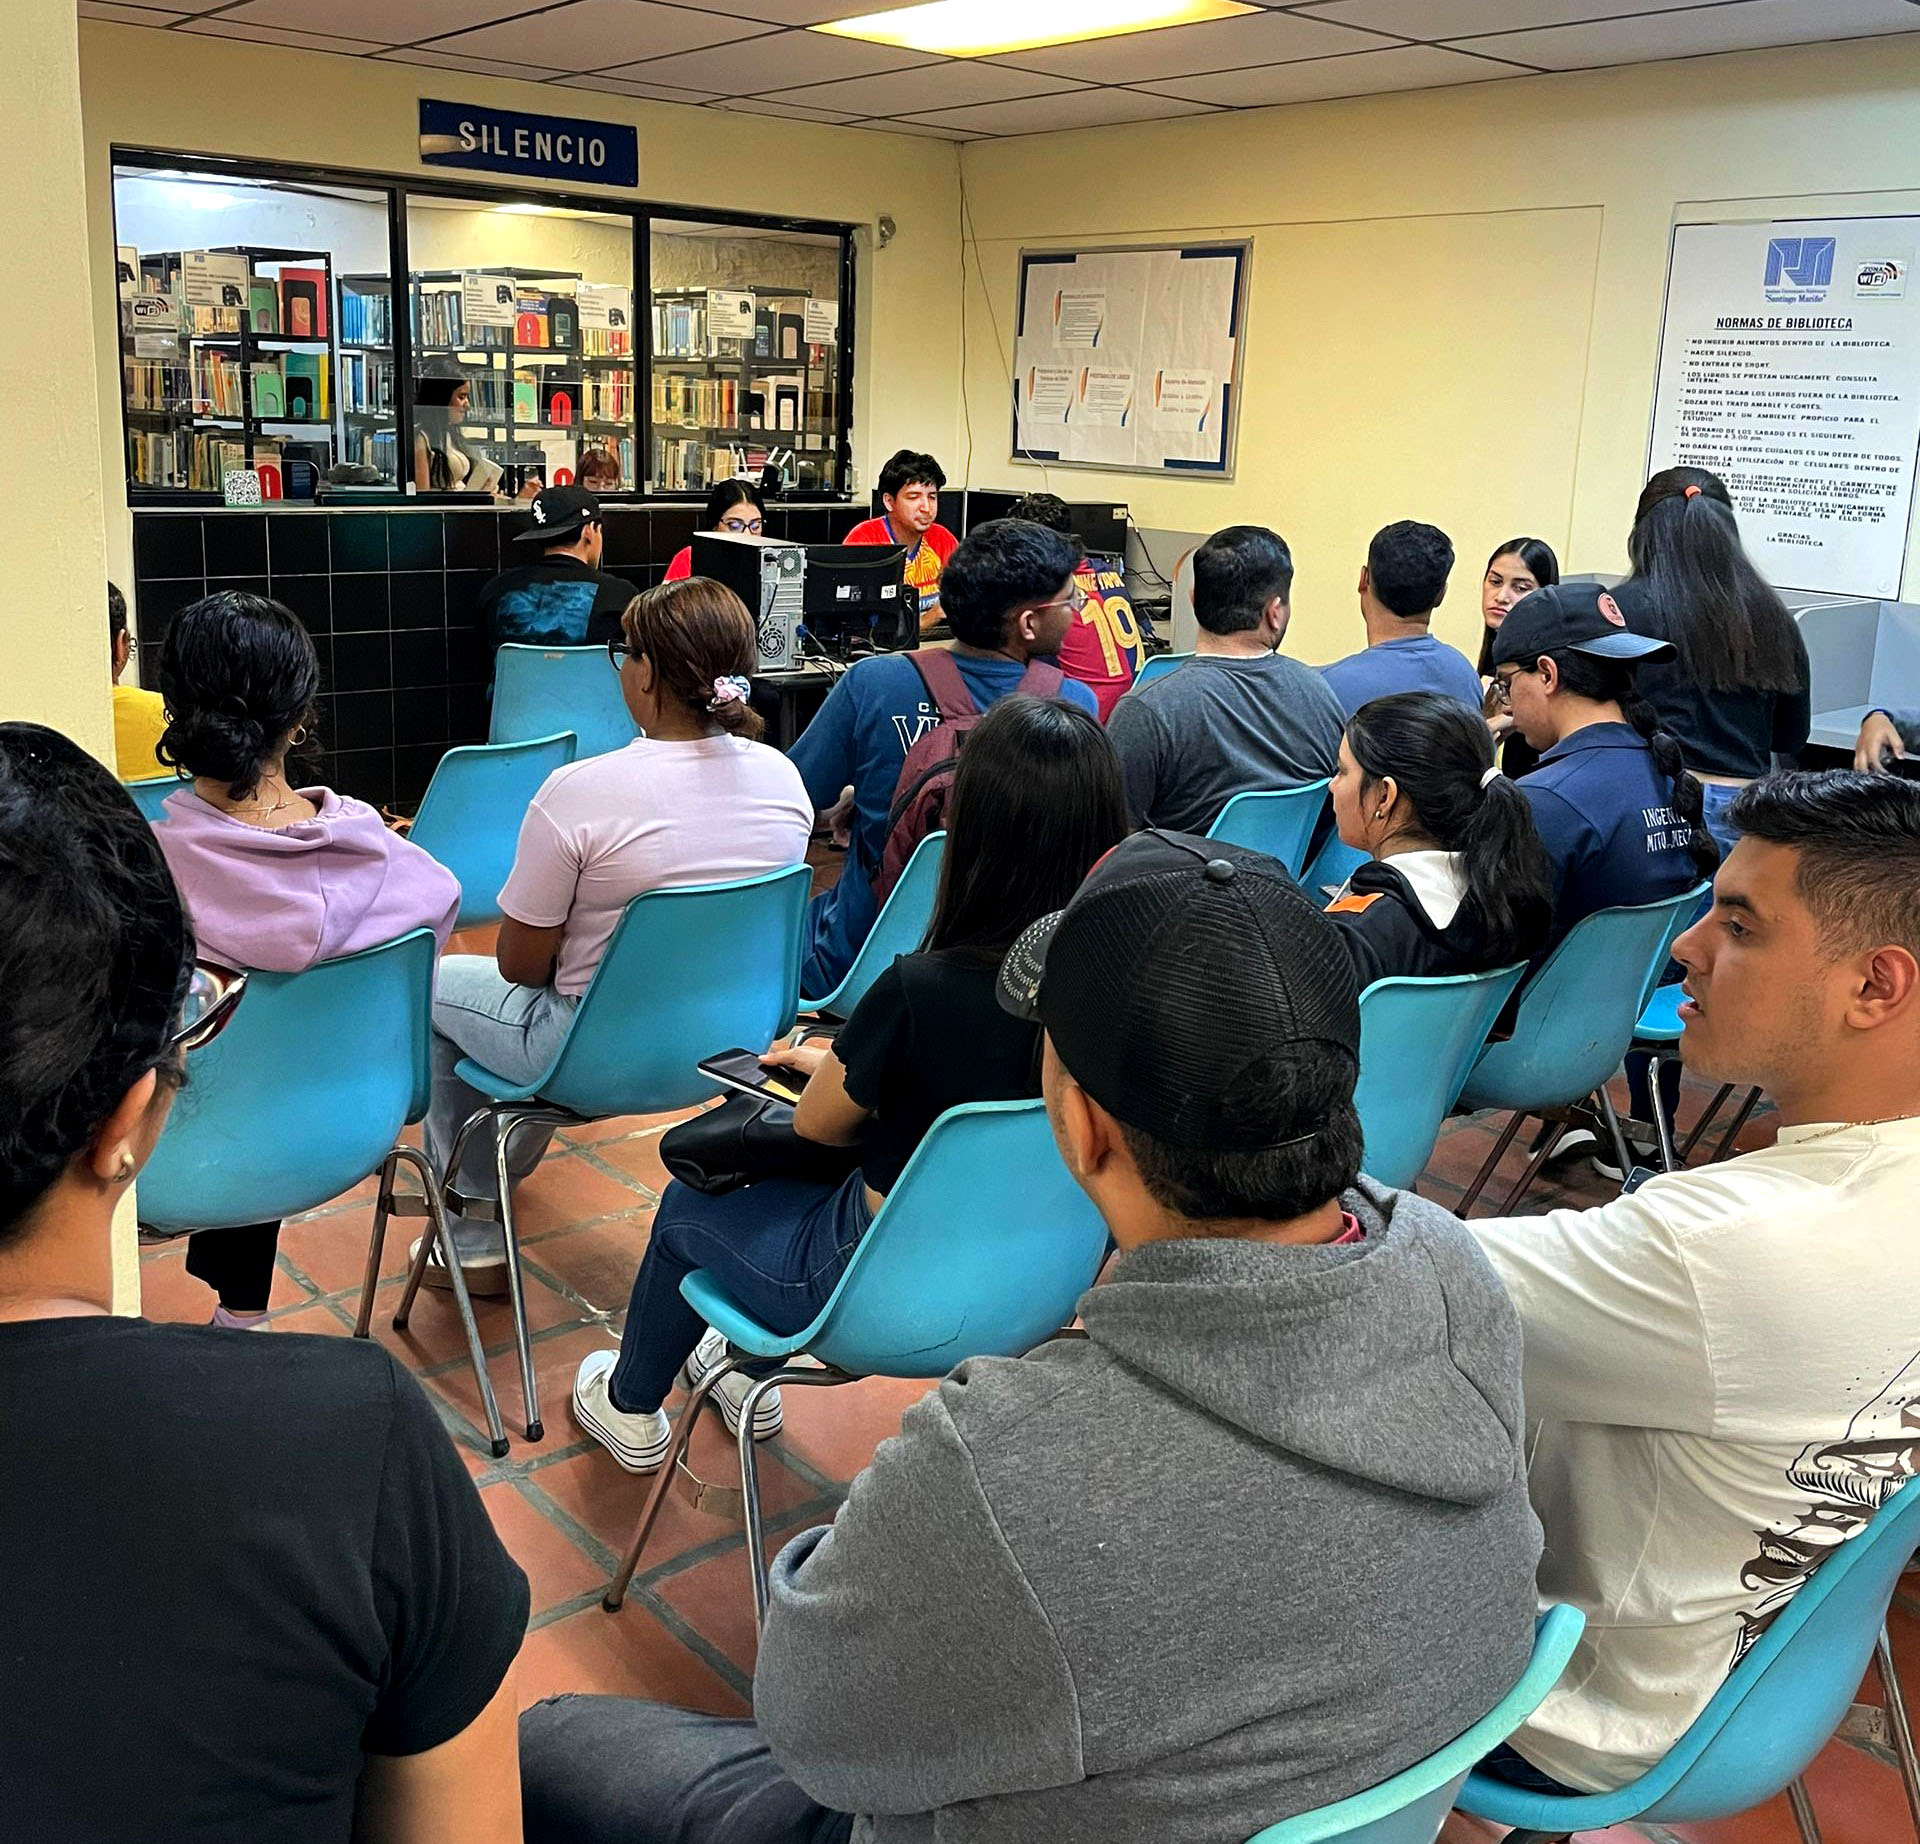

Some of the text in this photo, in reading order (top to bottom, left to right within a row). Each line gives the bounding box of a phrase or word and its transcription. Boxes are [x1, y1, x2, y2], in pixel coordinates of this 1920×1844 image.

[459, 121, 606, 167] SILENCIO
[1716, 317, 1853, 329] NORMAS DE BIBLIOTECA
[1080, 596, 1147, 677] 19
